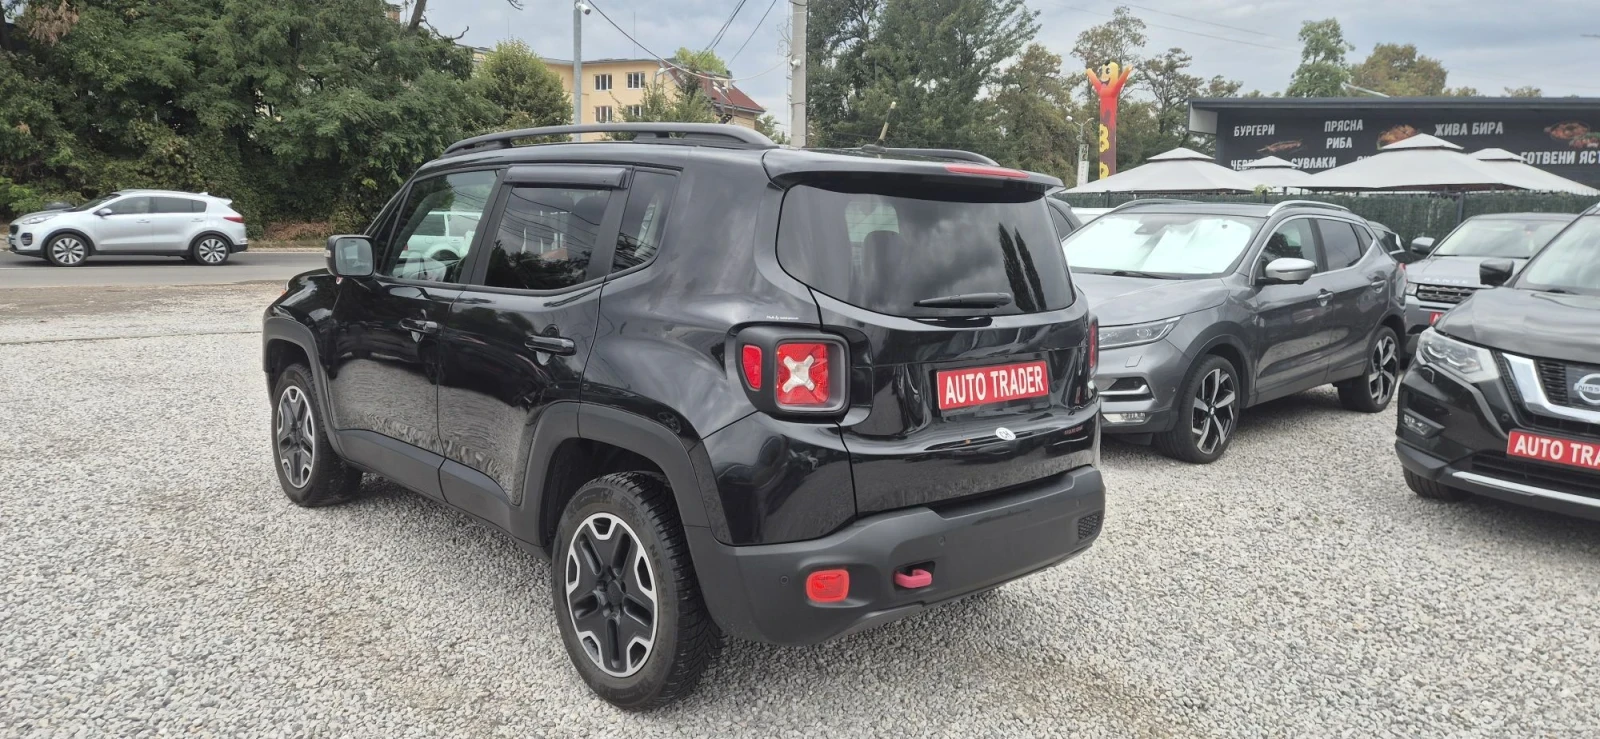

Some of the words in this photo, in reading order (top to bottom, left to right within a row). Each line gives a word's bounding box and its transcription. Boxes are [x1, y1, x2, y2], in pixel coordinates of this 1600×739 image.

[1234, 124, 1276, 137] БУРГЕРИ
[1324, 119, 1363, 133] ПРЯСНА
[1434, 123, 1468, 136] ЖИВА
[1472, 121, 1504, 135] БИРА
[1326, 137, 1353, 149] РИБА
[1291, 156, 1337, 169] СУВЛАКИ
[1520, 151, 1576, 165] ГОТВЕНИ
[946, 373, 986, 404] AUTO
[990, 365, 1044, 398] TRADER
[1514, 435, 1564, 460] AUTO
